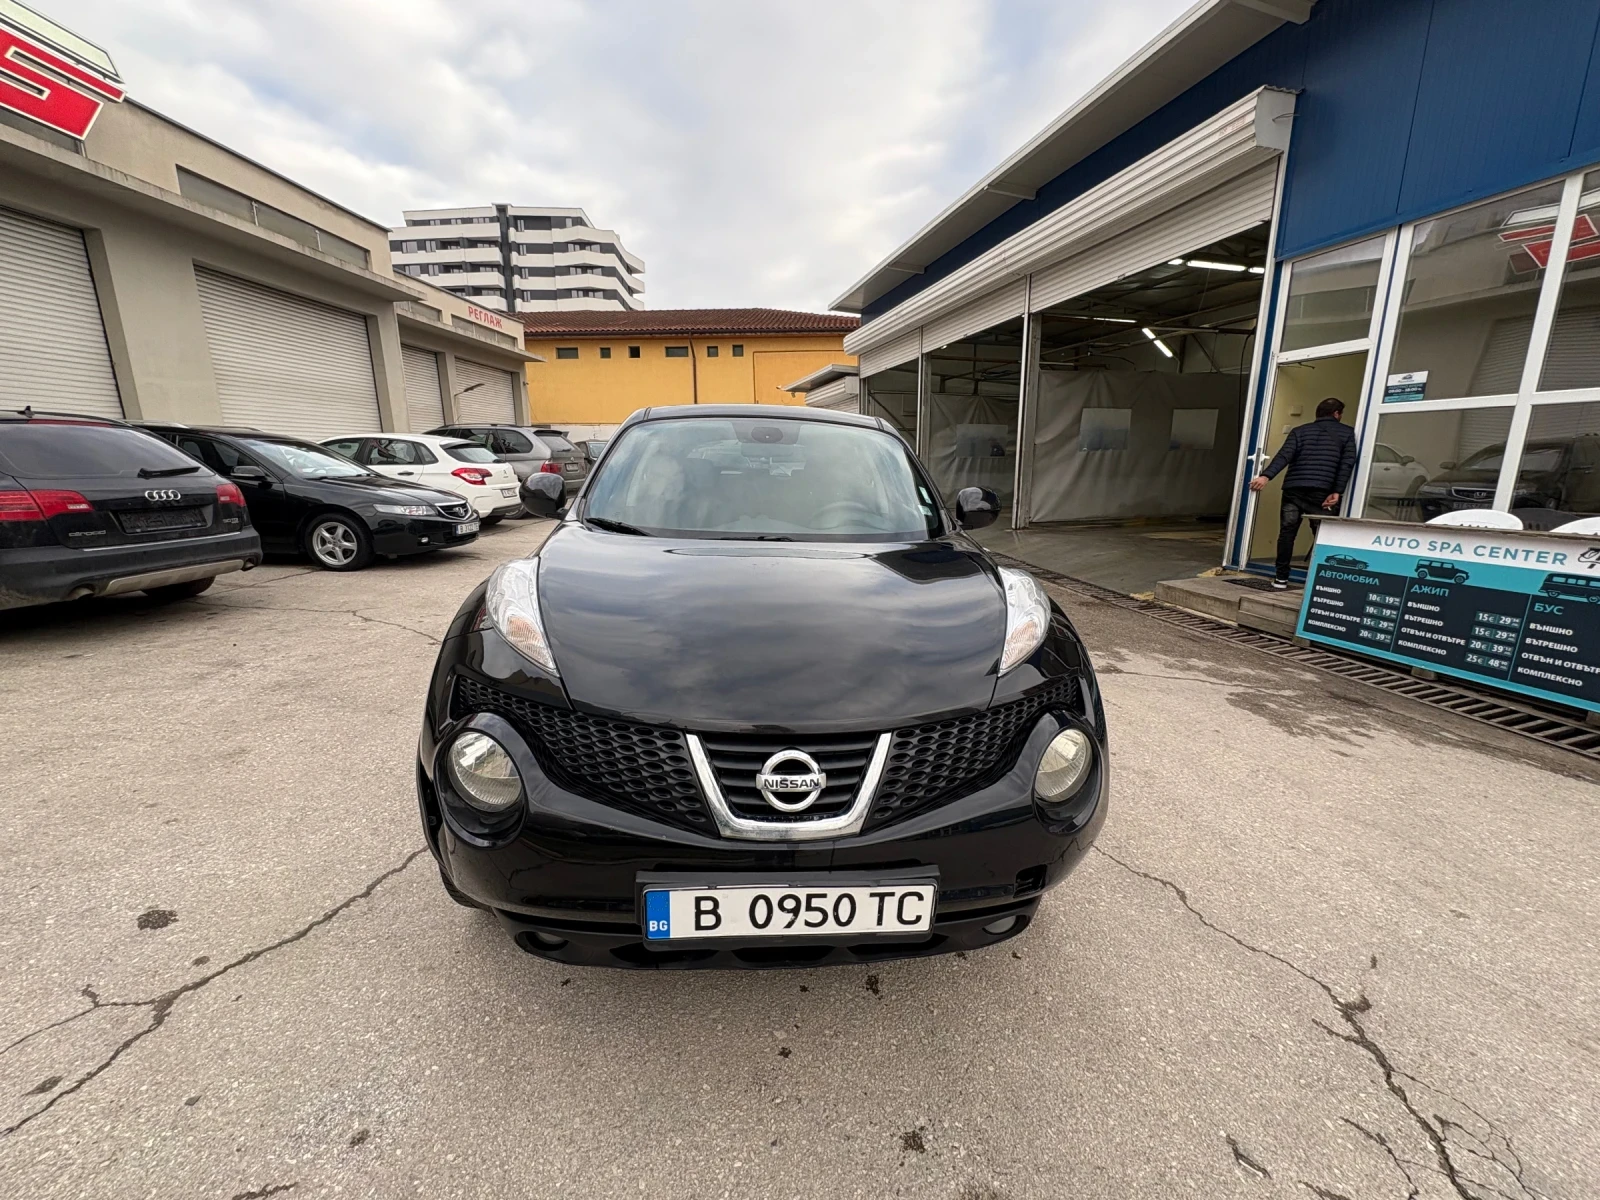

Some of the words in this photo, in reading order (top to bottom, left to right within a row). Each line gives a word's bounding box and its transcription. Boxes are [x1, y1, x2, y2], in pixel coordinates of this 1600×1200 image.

[468, 306, 502, 329] РЕГЛАЖ
[1371, 535, 1420, 550] AUTO
[1427, 541, 1464, 555] SPA
[1473, 544, 1568, 566] CENTER
[1318, 570, 1379, 586] АВТОМОБИЛ
[1410, 584, 1450, 597] ДЖИП
[1407, 601, 1440, 612] ВЪНШНО
[1534, 603, 1564, 615] БУС
[1404, 614, 1444, 627] ВЪТРЕШНО
[1401, 627, 1425, 638] ОТВЪН
[1432, 633, 1466, 646] ОТВЪТРЕ
[1529, 622, 1574, 636] ВЪНШНО
[1398, 640, 1447, 655] КОМПЛЕКСНО
[1525, 637, 1578, 653] ВЪТРЕШНО
[1521, 652, 1554, 664] ОТВЪН
[1554, 658, 1562, 666] И
[1517, 666, 1583, 687] КОМПЛЕКСНО
[764, 778, 819, 789] NISSAN
[649, 920, 668, 932] BG
[694, 895, 722, 931] B
[748, 892, 857, 930] 0950
[869, 890, 924, 926] TC
